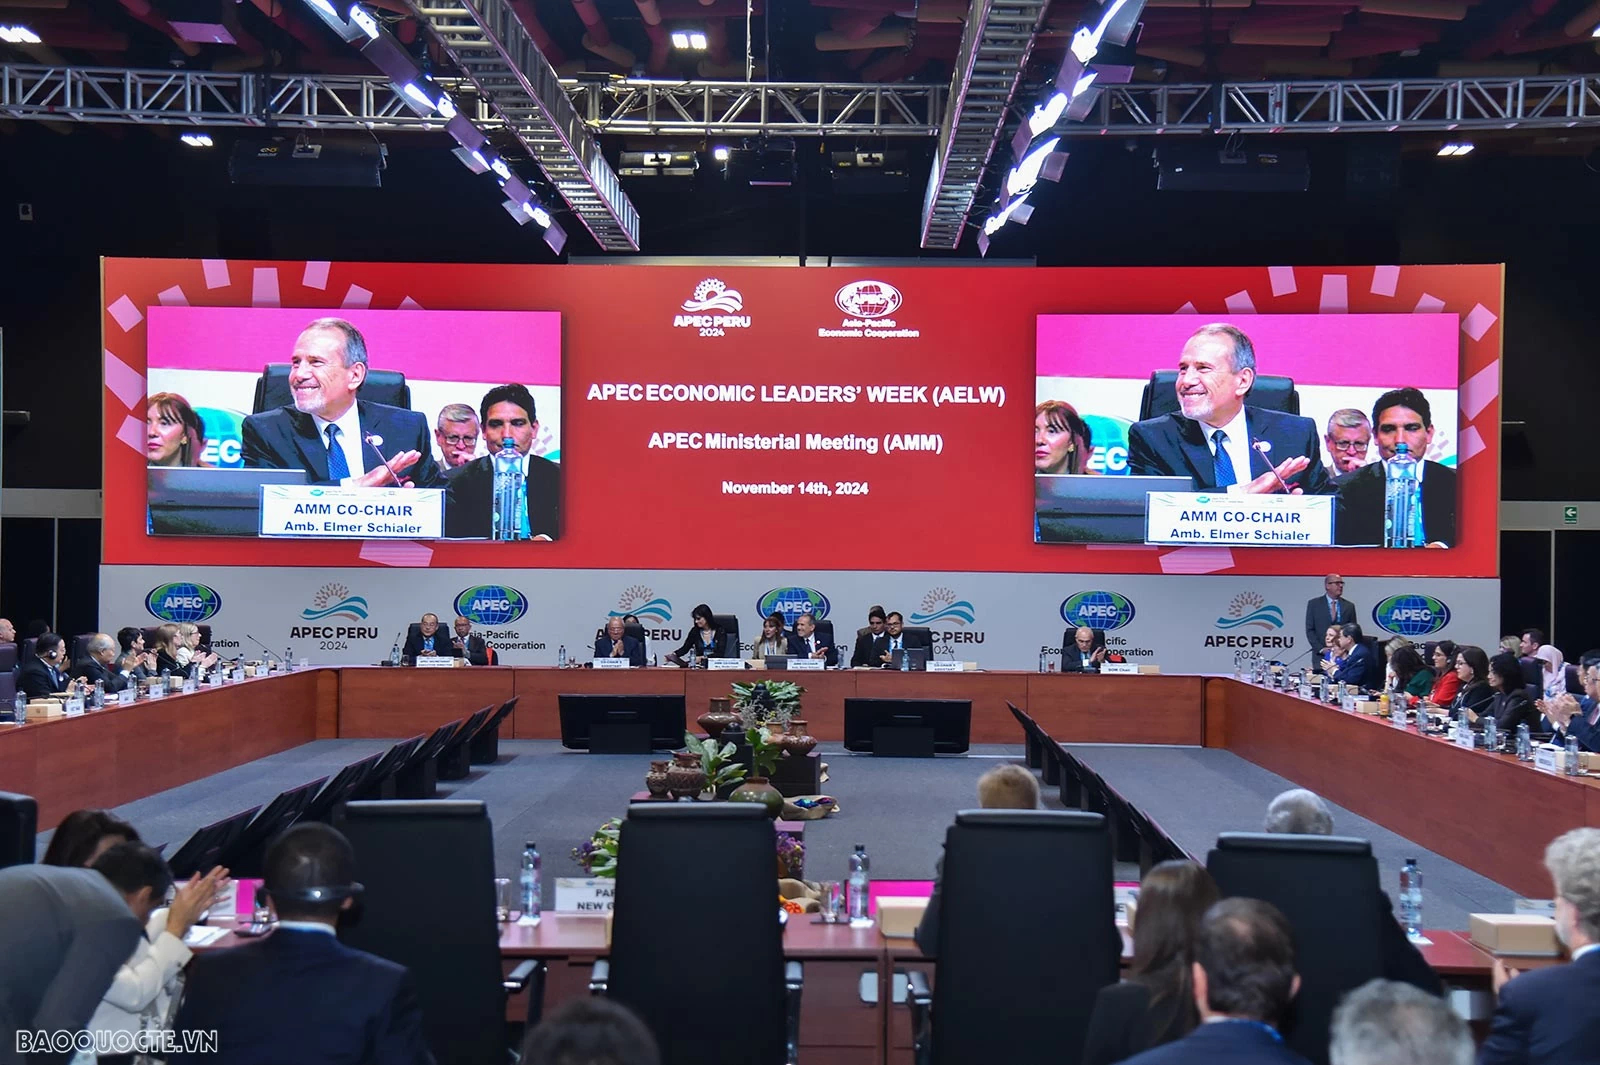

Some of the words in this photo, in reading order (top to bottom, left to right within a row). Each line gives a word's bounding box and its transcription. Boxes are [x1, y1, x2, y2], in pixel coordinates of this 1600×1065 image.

[673, 315, 713, 327] APEC
[713, 315, 751, 328] PERU
[842, 318, 897, 327] Asia-Pacific
[699, 327, 725, 337] 2024
[818, 328, 863, 337] Economic
[864, 328, 920, 339] Cooperation
[587, 384, 643, 401] APEC
[645, 384, 756, 402] ECONOMIC
[761, 385, 862, 403] LEADERS’
[866, 386, 928, 403] WEEK
[932, 386, 1006, 407] (AELW)
[648, 432, 703, 449] APEC
[705, 432, 800, 450] Ministerial
[805, 433, 879, 454] Meeting
[883, 433, 943, 455] (AMM)
[200, 438, 242, 464] EC
[1086, 446, 1129, 471] EC
[721, 480, 795, 494] November
[797, 481, 832, 497] 14th,
[835, 481, 870, 495] 2024
[293, 503, 331, 515] AMM
[336, 504, 413, 517] CO-CHAIR
[1180, 510, 1217, 522] AMM
[1223, 511, 1301, 524] CO-CHAIR
[284, 521, 319, 532] Amb.
[323, 521, 363, 533] Elmer
[367, 522, 422, 534] Schialer
[1170, 528, 1205, 539] Amb.
[1209, 528, 1250, 540] Elmer
[1254, 529, 1311, 541] Schialer
[164, 596, 203, 609] APEC
[472, 599, 510, 611] APEC
[775, 601, 812, 613] APEC
[1078, 605, 1117, 617] APEC
[1391, 609, 1432, 621] APEC
[290, 626, 333, 639] APEC
[336, 627, 378, 639] PERU
[469, 630, 519, 640] sia-Pacific
[943, 631, 985, 644] PERU
[210, 639, 240, 648] ration
[319, 640, 348, 651] 2024
[486, 641, 546, 651] Cooperation
[1204, 636, 1249, 648] APEC
[1251, 636, 1294, 649] PERU
[934, 645, 955, 655] 024
[1106, 648, 1154, 657] operation
[577, 901, 603, 910] NEW
